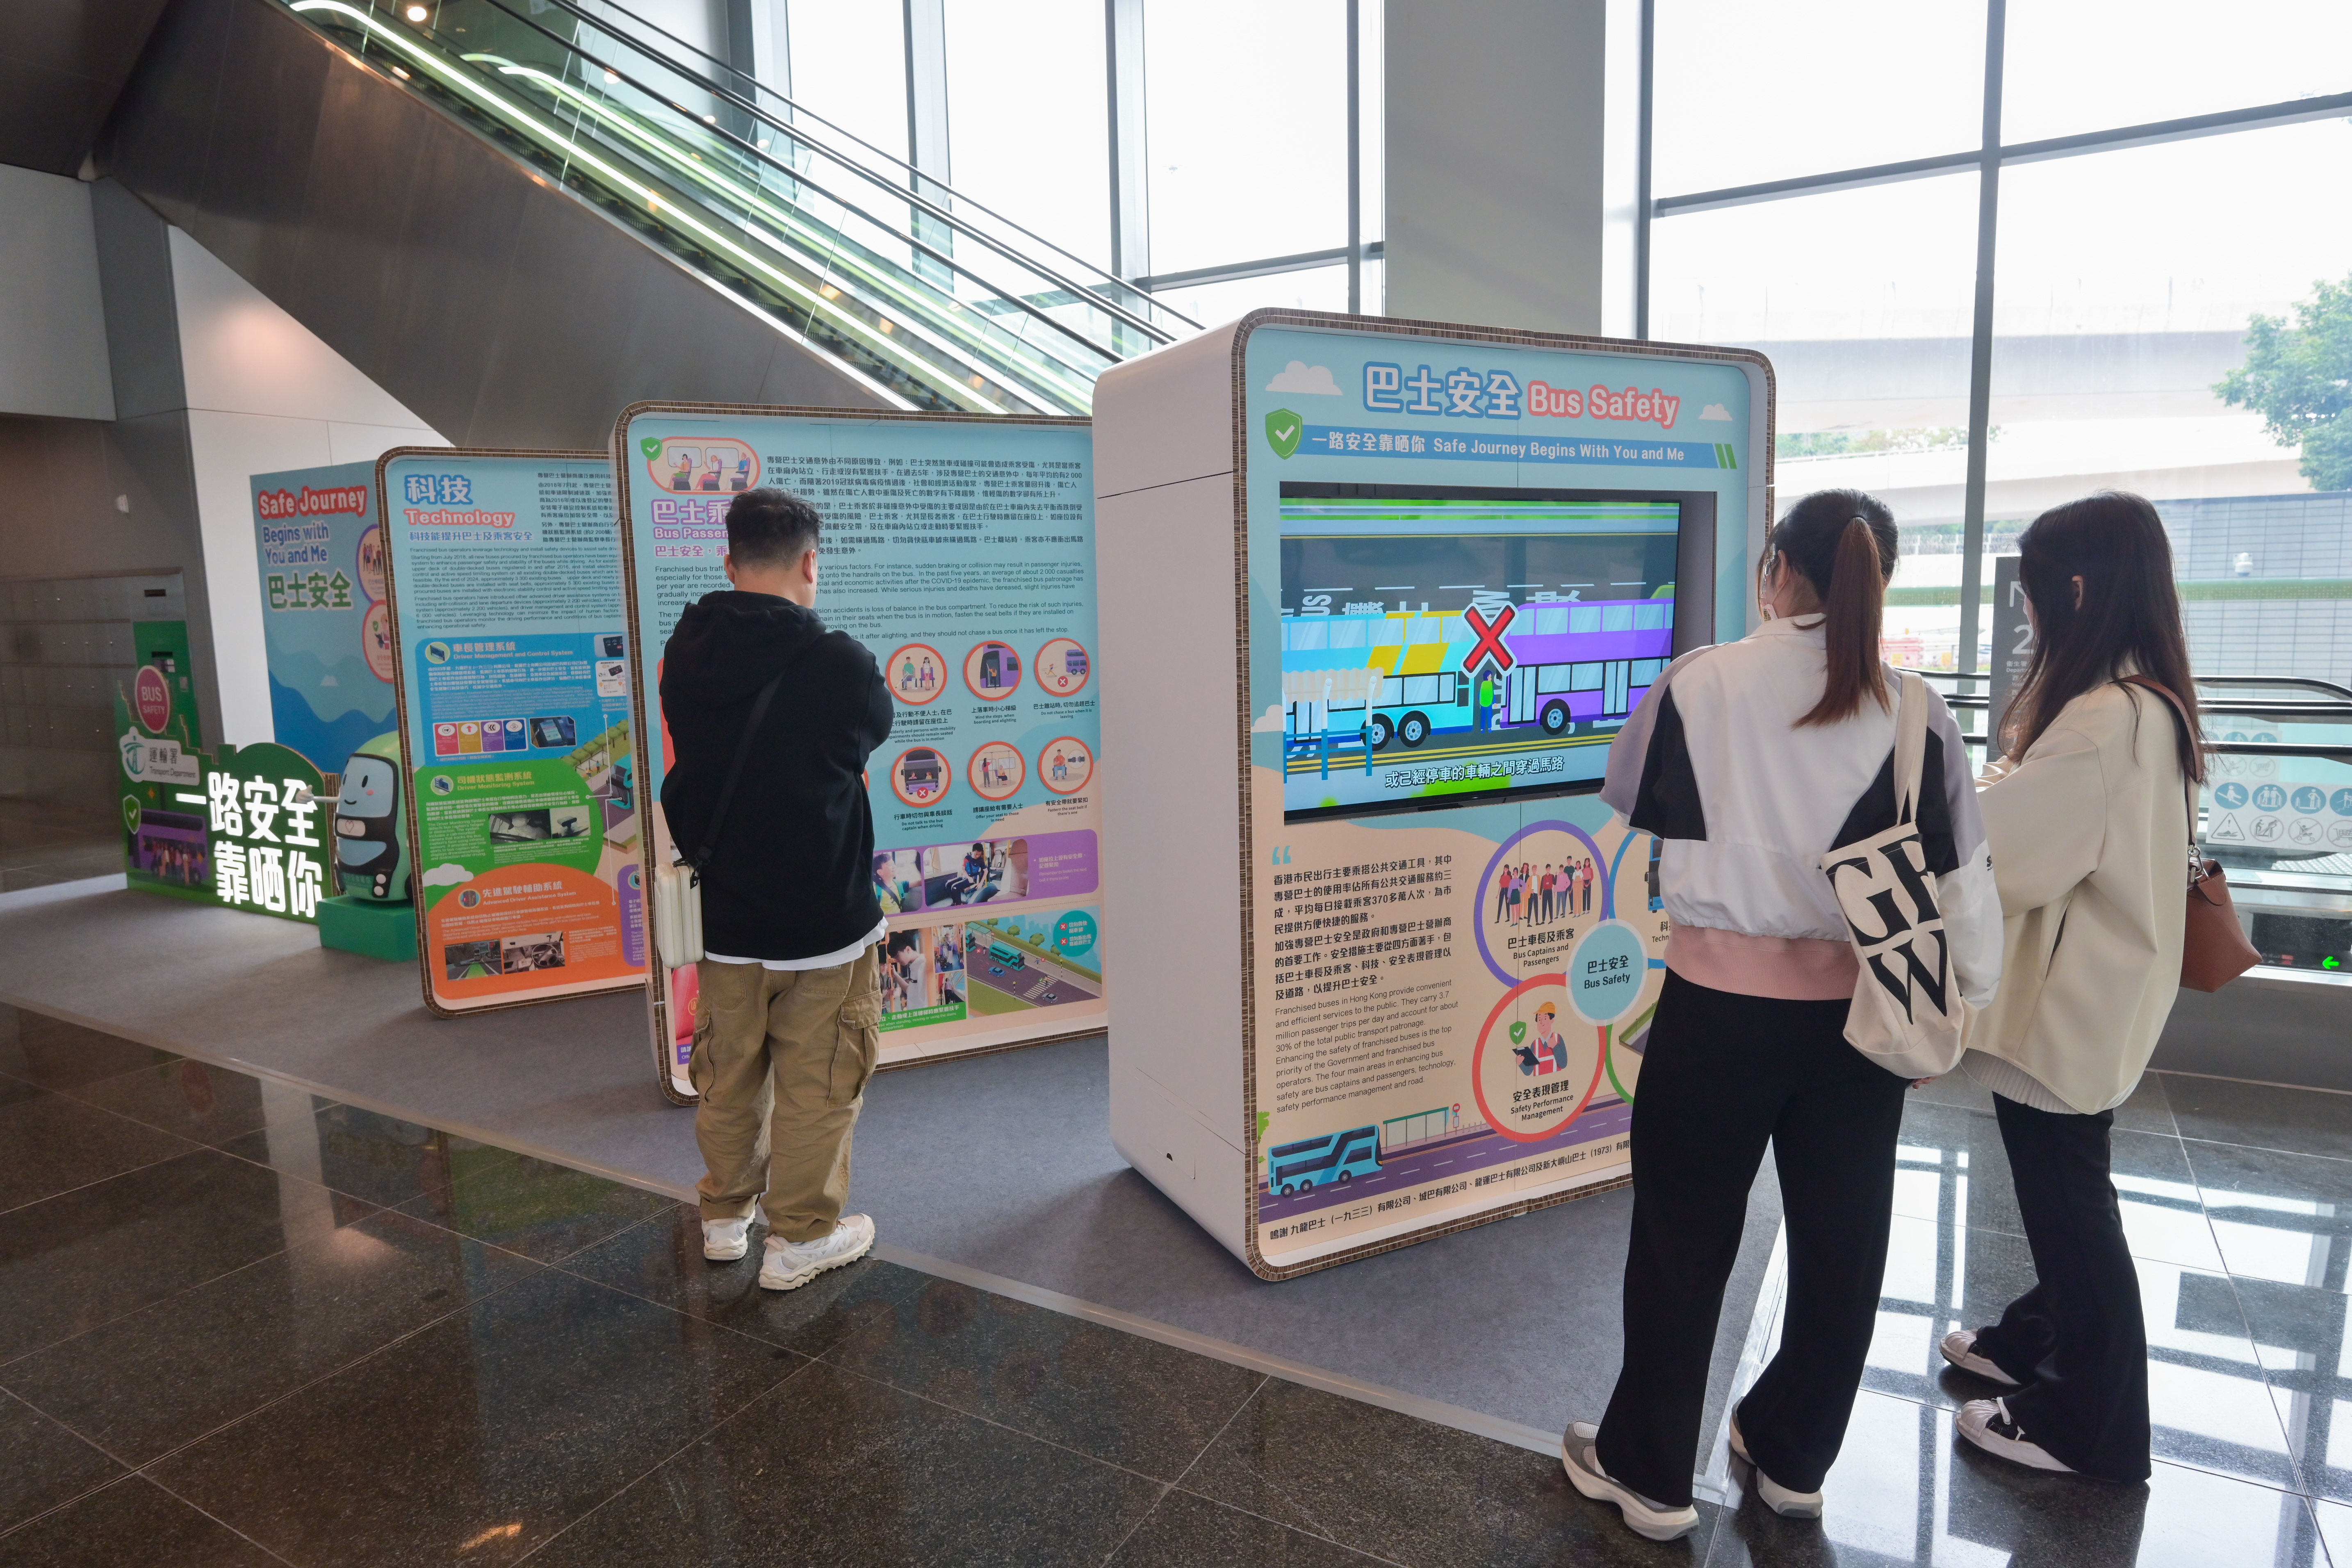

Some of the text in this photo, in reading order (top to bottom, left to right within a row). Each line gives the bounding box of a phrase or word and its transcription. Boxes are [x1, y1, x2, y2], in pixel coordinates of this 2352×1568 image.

[1366, 365, 1678, 426] 巴士安全 Bus Safety
[1312, 431, 1684, 460] 一路安全靠晒你 Safe Journey Begins With You and Me
[406, 476, 471, 503] 科技
[260, 489, 365, 515] Safe Journey
[406, 511, 513, 526] Technology
[263, 522, 328, 545] Begins with
[410, 532, 533, 541] 科技能提升巴士及乘客安全
[655, 528, 679, 538] Bus
[265, 546, 327, 564] You and Me
[268, 571, 352, 609] 巴士安全
[141, 686, 162, 701] BUS
[144, 706, 165, 714] SAFETY
[971, 705, 1016, 713] 上落車時小心梯級
[1033, 700, 1095, 709] 巴士離站時，切勿追趕巴士
[175, 772, 320, 848] 一路安全
[973, 803, 1023, 813] 請讓座給有需要人士
[1045, 797, 1088, 806] 有安全帶就要緊扣
[894, 809, 952, 820] 行車時切勿與車長談話
[214, 840, 323, 918] 靠晒你
[1660, 921, 1670, 932] 科
[1508, 928, 1574, 949] 巴士車長及乘客
[1513, 943, 1568, 960] Bus Captains and
[1523, 956, 1559, 967] Passengers
[1588, 955, 1629, 974] 巴士安全
[1584, 973, 1630, 989] Bus Safety
[1275, 1002, 1316, 1016] Franchised
[1318, 1000, 1339, 1008] buses
[1389, 986, 1414, 998] provide
[1416, 979, 1451, 991] convenient
[1276, 1019, 1289, 1028] and
[1291, 1013, 1321, 1025] efficient
[1323, 1010, 1353, 1019] services
[1377, 1001, 1398, 1012] public.
[1439, 991, 1449, 999] 3.7
[1276, 1031, 1299, 1040] million
[1301, 1024, 1339, 1037] passenger
[1340, 1020, 1356, 1029] trips
[1358, 1018, 1370, 1027] per
[1387, 1011, 1399, 1020] and
[1401, 1006, 1427, 1017] account
[1440, 1001, 1458, 1010] about
[1276, 1042, 1292, 1052] 30%
[1294, 1041, 1301, 1049] of
[1317, 1035, 1332, 1045] total
[1335, 1032, 1355, 1043] public
[1358, 1025, 1388, 1037] transport
[1390, 1020, 1425, 1033] patronage.
[1276, 1052, 1313, 1064] Enhancing
[1329, 1044, 1351, 1054] safety
[1362, 1035, 1398, 1048] franchised
[1400, 1032, 1420, 1041] buses
[1513, 1080, 1568, 1103] 安全表現管理
[1511, 1095, 1573, 1114] Safety Performance
[1522, 1105, 1563, 1121] Management
[1270, 1228, 1288, 1240] 鳴謝
